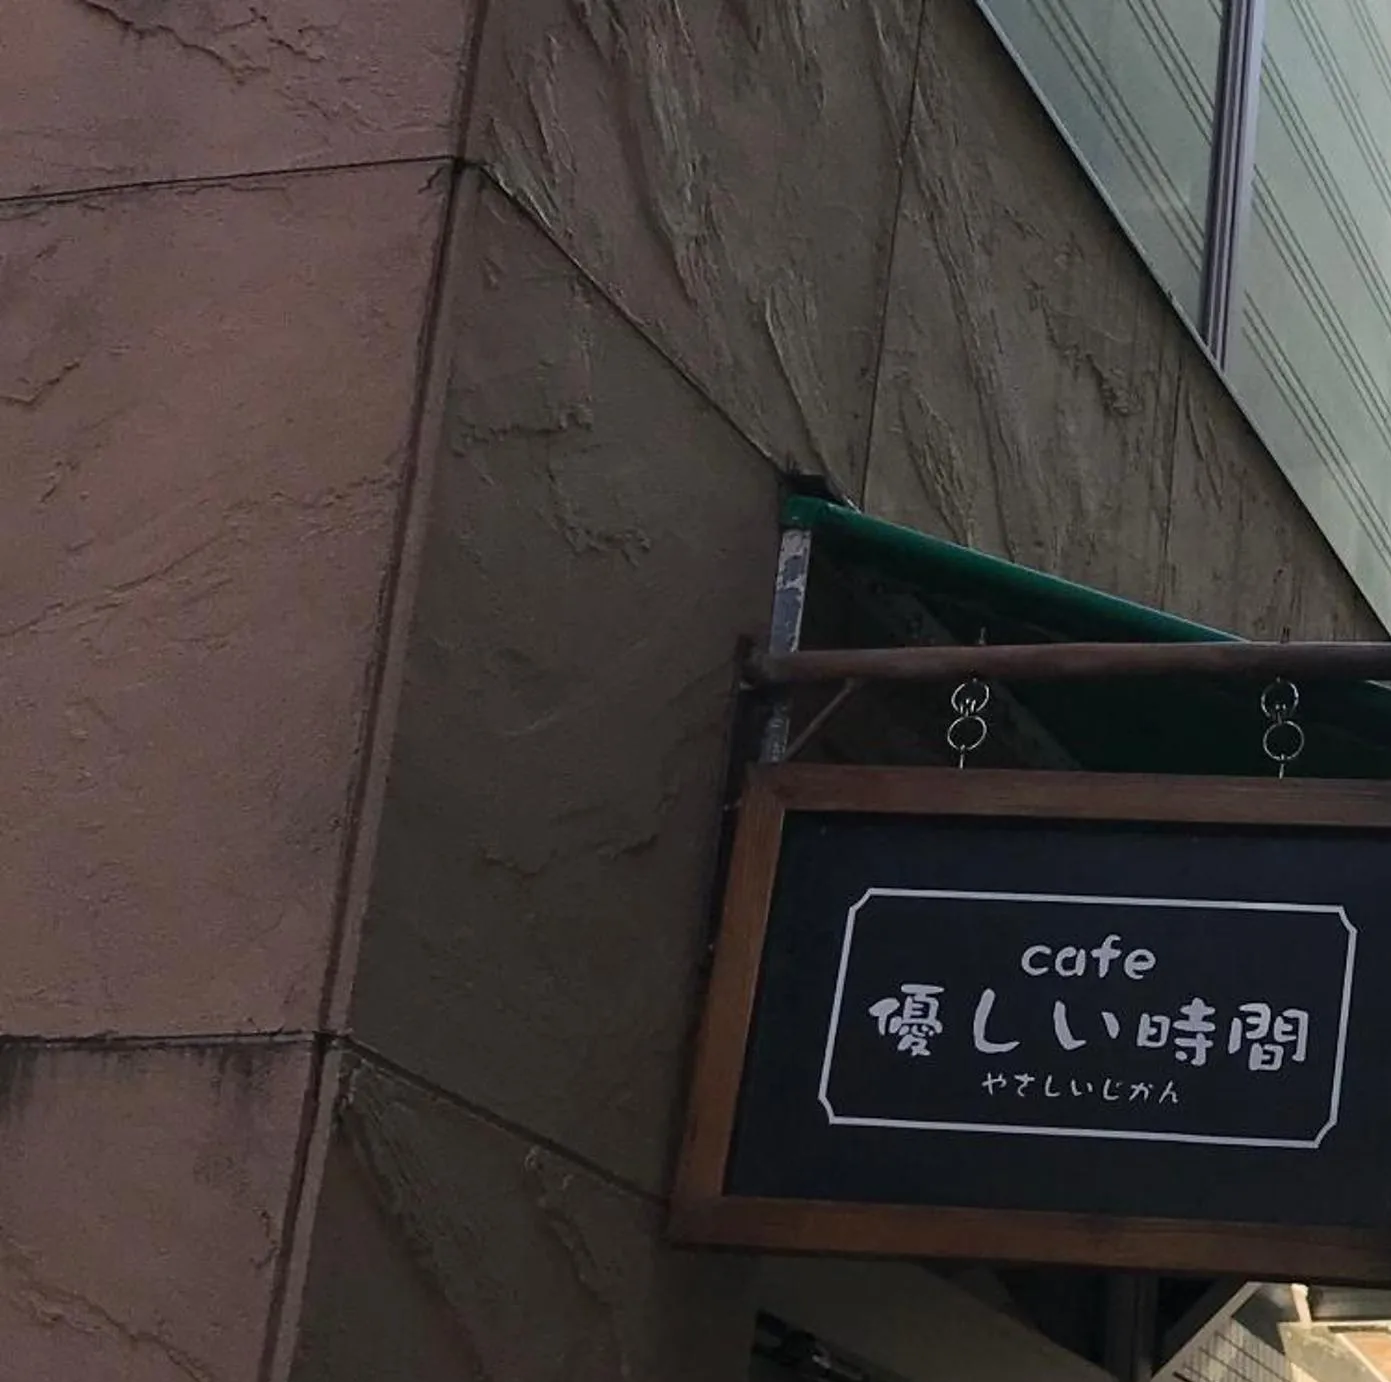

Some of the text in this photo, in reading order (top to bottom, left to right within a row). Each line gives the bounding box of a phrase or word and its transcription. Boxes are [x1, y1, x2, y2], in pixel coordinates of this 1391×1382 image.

[1020, 934, 1156, 980] cafe
[868, 983, 1309, 1071] 優しい時間
[981, 1071, 1180, 1104] やさしいじかん
